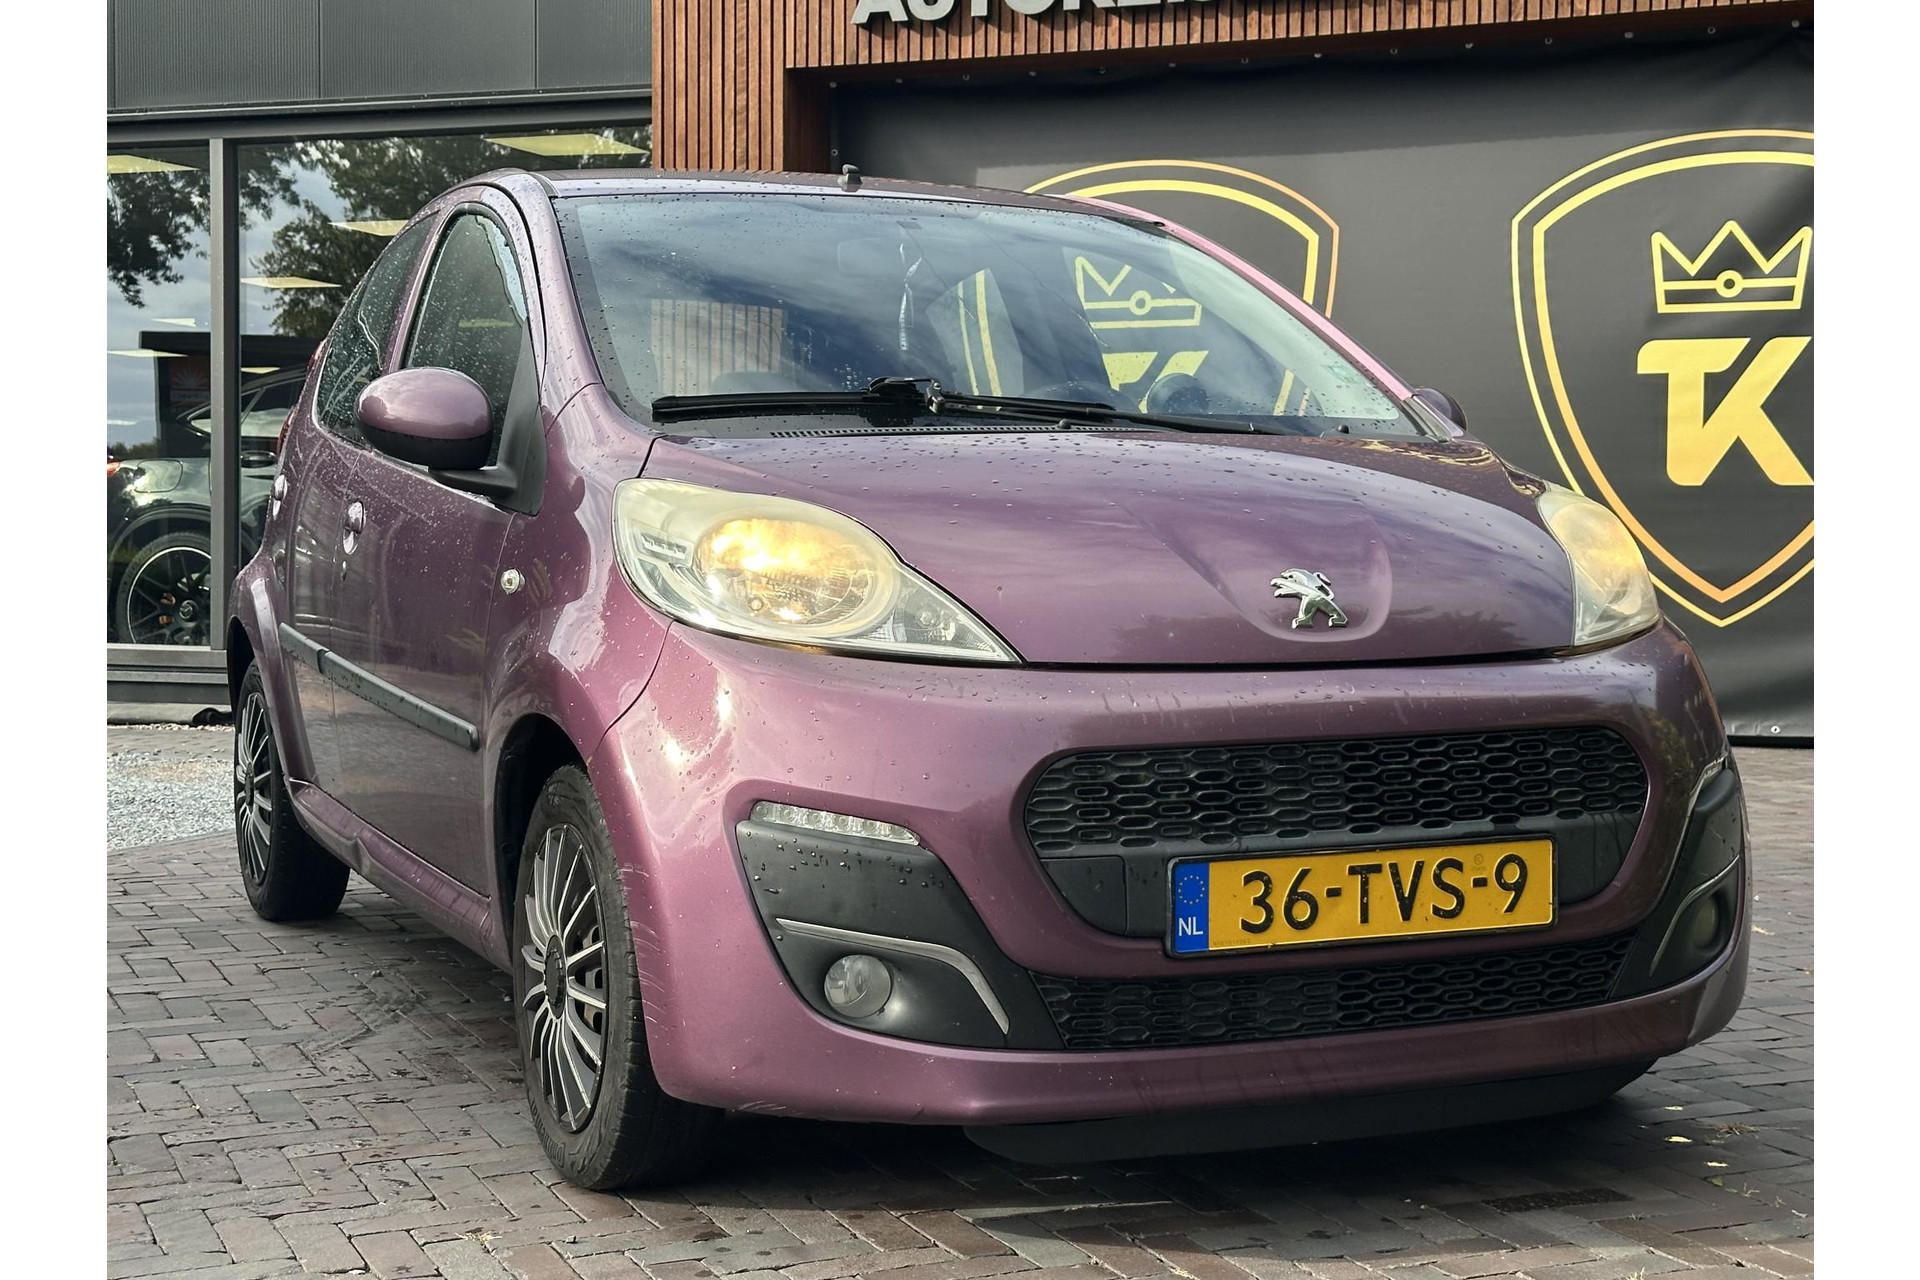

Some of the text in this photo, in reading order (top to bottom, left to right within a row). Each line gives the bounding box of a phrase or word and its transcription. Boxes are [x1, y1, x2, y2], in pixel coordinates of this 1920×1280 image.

[1637, 336, 1814, 486] TK
[1178, 916, 1204, 937] NL
[1240, 852, 1529, 934] 36-TVS-9
